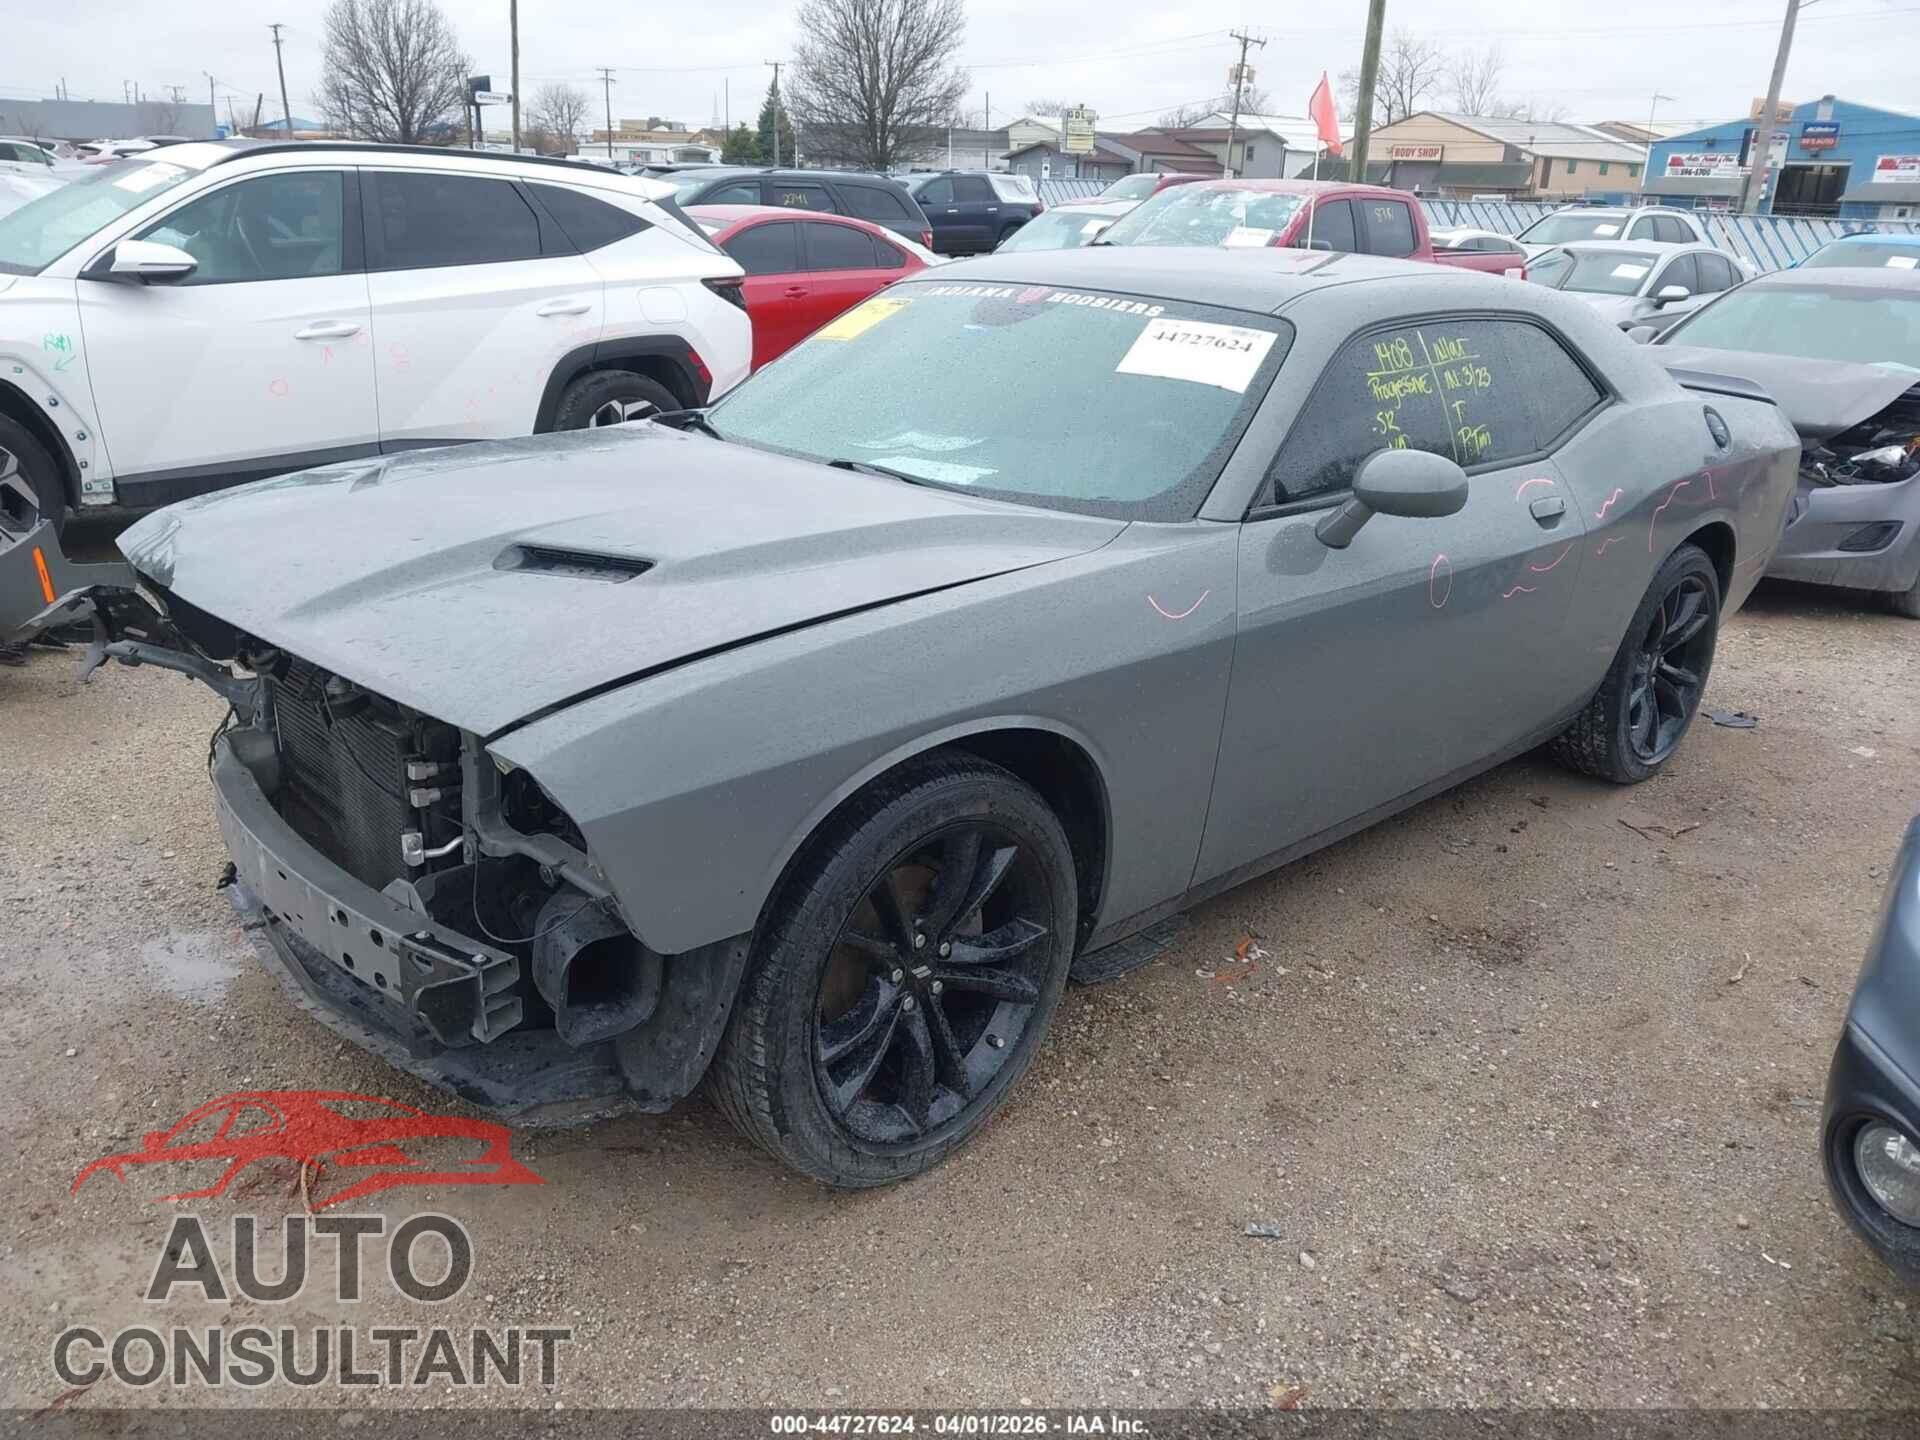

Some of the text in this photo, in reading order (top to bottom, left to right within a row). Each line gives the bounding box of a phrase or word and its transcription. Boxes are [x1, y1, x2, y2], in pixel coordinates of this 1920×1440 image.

[1394, 147, 1440, 158] BODY SHOP
[924, 286, 1014, 299] INDIANA
[1047, 292, 1166, 317] HOOSIERS
[1152, 330, 1254, 353] 44727624
